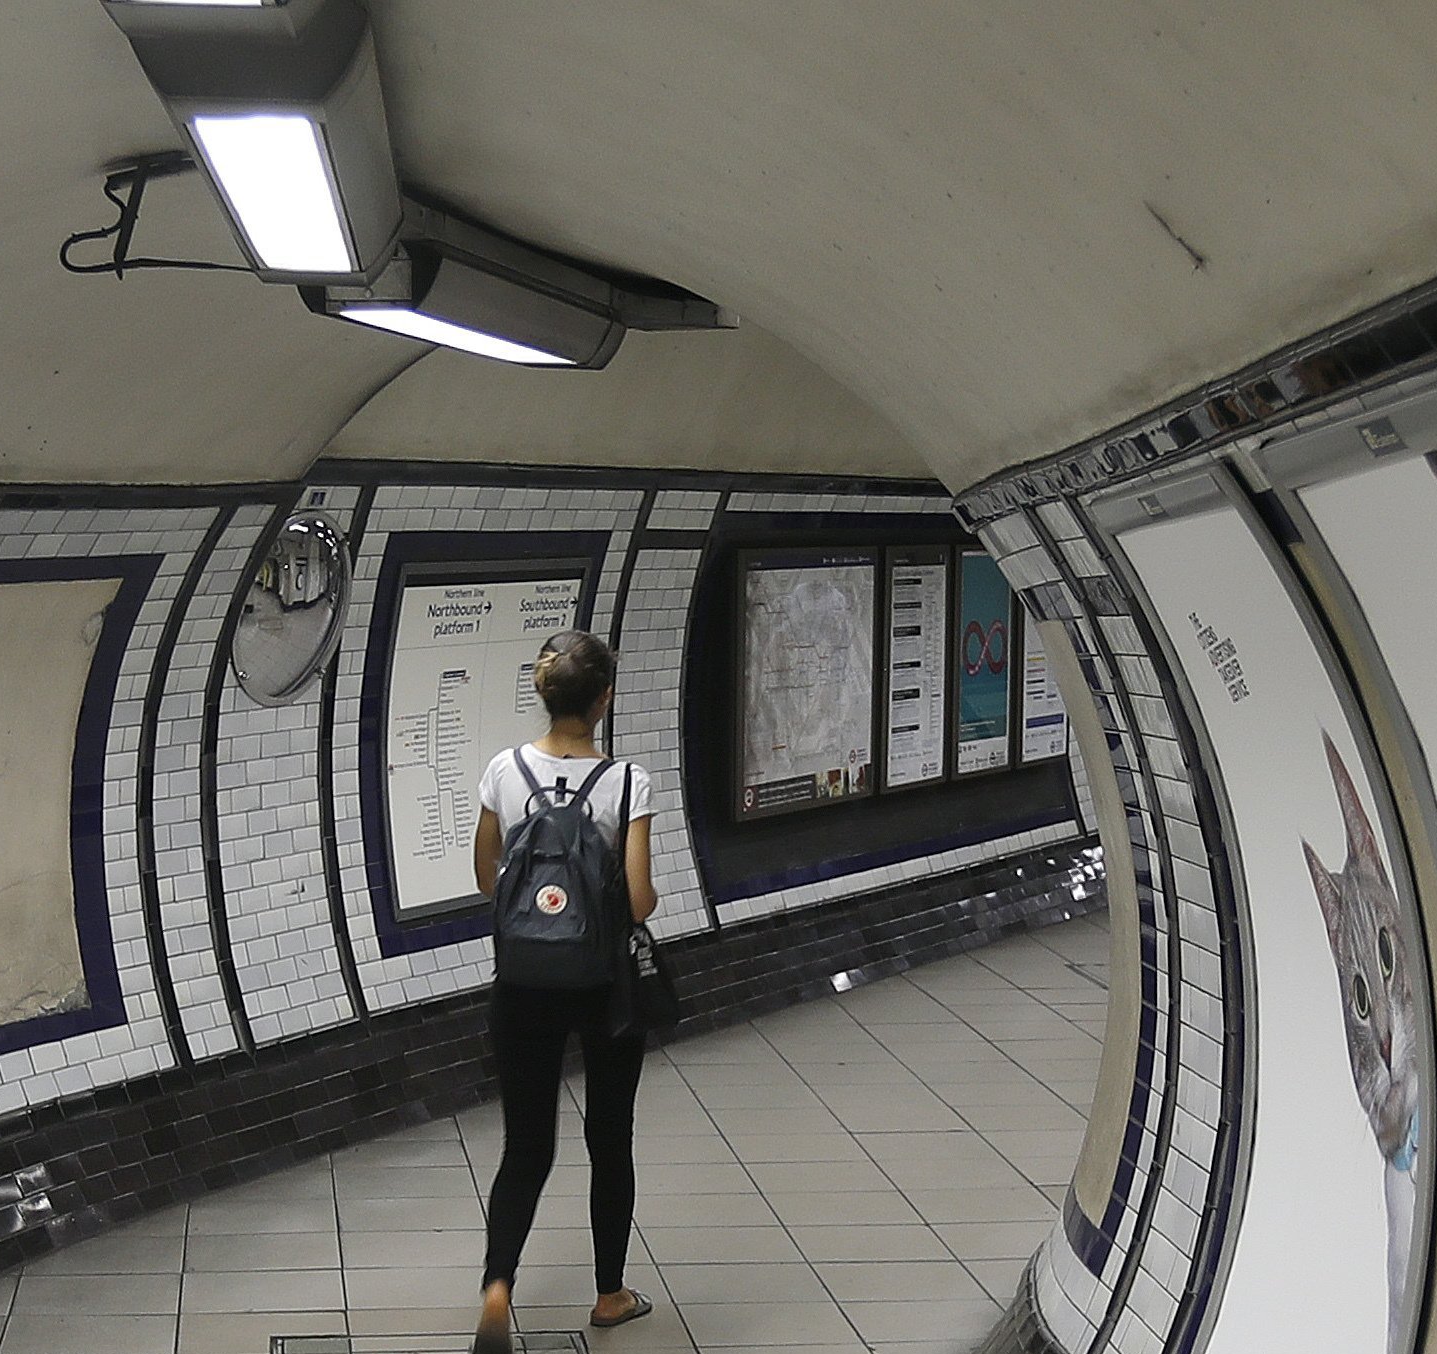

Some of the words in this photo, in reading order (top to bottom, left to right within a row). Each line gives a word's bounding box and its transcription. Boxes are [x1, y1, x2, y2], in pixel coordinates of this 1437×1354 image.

[445, 588, 471, 599] Northern
[535, 585, 557, 594] Northern
[427, 602, 482, 617] Northbound
[519, 597, 569, 612] Southbound
[433, 621, 473, 638] platform
[476, 620, 480, 631] 1
[523, 615, 559, 632] platform
[561, 614, 566, 627] 2
